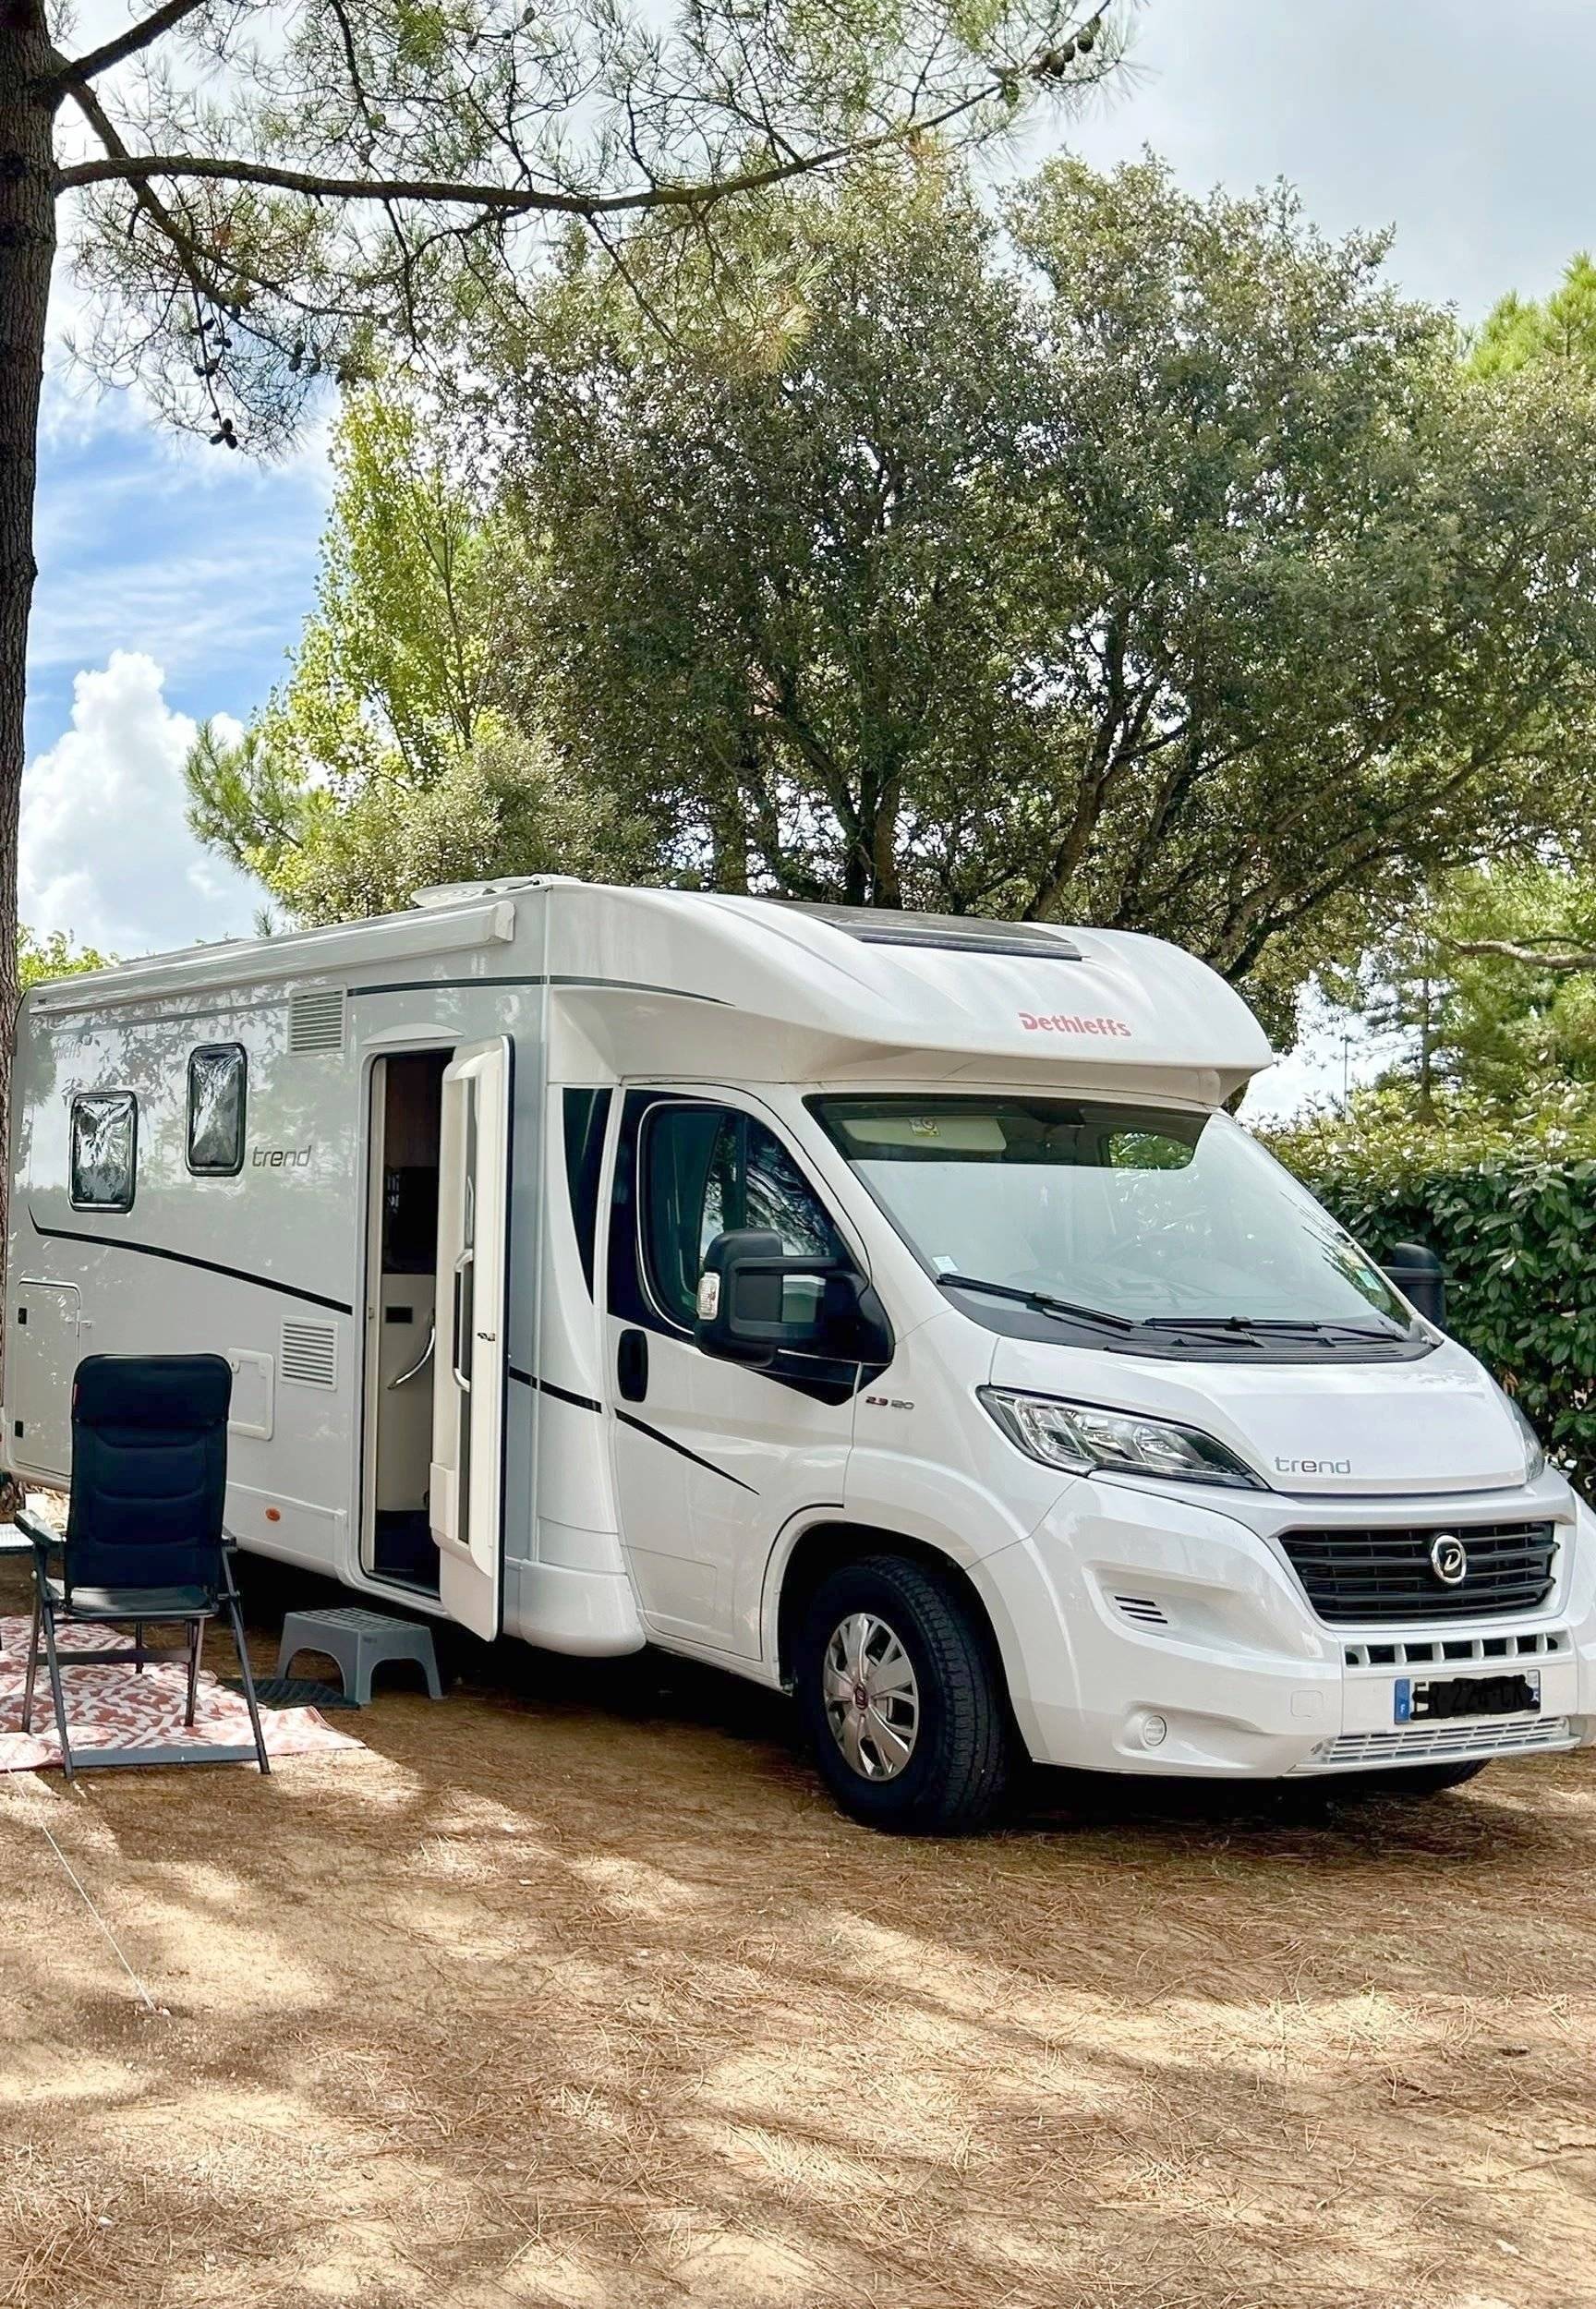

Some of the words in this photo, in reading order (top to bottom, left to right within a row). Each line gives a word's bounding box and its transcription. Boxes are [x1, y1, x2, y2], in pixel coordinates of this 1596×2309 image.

[1018, 1012, 1132, 1037] Dethleffs
[252, 1144, 312, 1167] trend
[1275, 1457, 1351, 1474] trend
